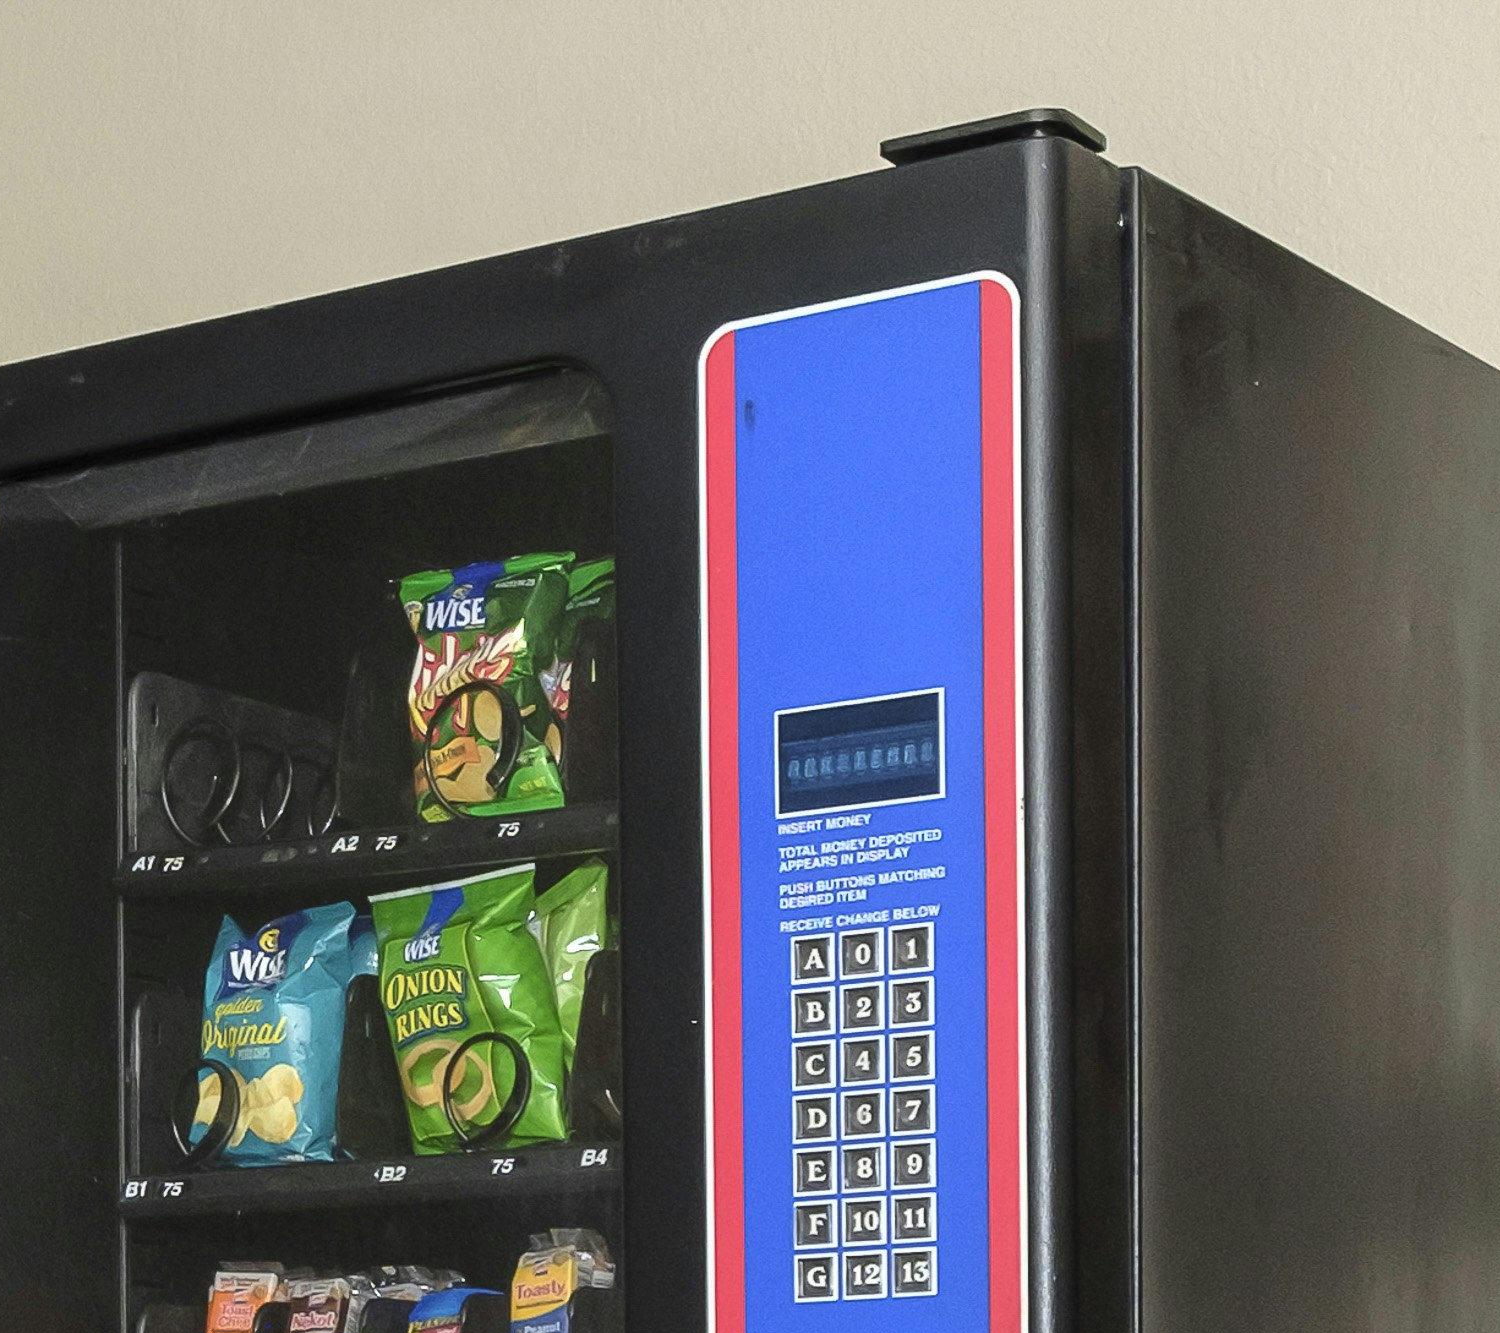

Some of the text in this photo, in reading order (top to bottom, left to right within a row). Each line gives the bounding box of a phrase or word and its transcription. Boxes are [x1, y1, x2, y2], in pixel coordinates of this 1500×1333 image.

[426, 597, 485, 631] WISE
[777, 814, 872, 835] INSERT MONEY
[132, 821, 521, 872] A1 75 A2 75 75
[779, 829, 942, 860] TOTAL MONEY DEPOSITED
[779, 847, 910, 873] APPEARS IN DISPLAY
[779, 866, 946, 896] PUSH BUTTONS MATCHING
[780, 889, 868, 910] DESIRED ITEM
[780, 904, 941, 933] RECEIVE CHANGE BELOW
[405, 935, 440, 962] WISE
[804, 938, 918, 970] A 0 1
[387, 968, 463, 1010] ONION
[215, 997, 263, 1019] golden
[396, 1003, 463, 1042] RINGS
[805, 991, 922, 1024] B 2 3
[202, 1015, 288, 1057] Original
[805, 1045, 922, 1077] C 4 5
[807, 1100, 921, 1130] D 6 7
[125, 1149, 608, 1198] B1 75 B2 75 B4
[807, 1153, 923, 1183] E 8 9
[809, 1207, 927, 1236] F 10 11
[807, 1260, 929, 1288] G 12 13
[516, 1280, 566, 1300] Toasty
